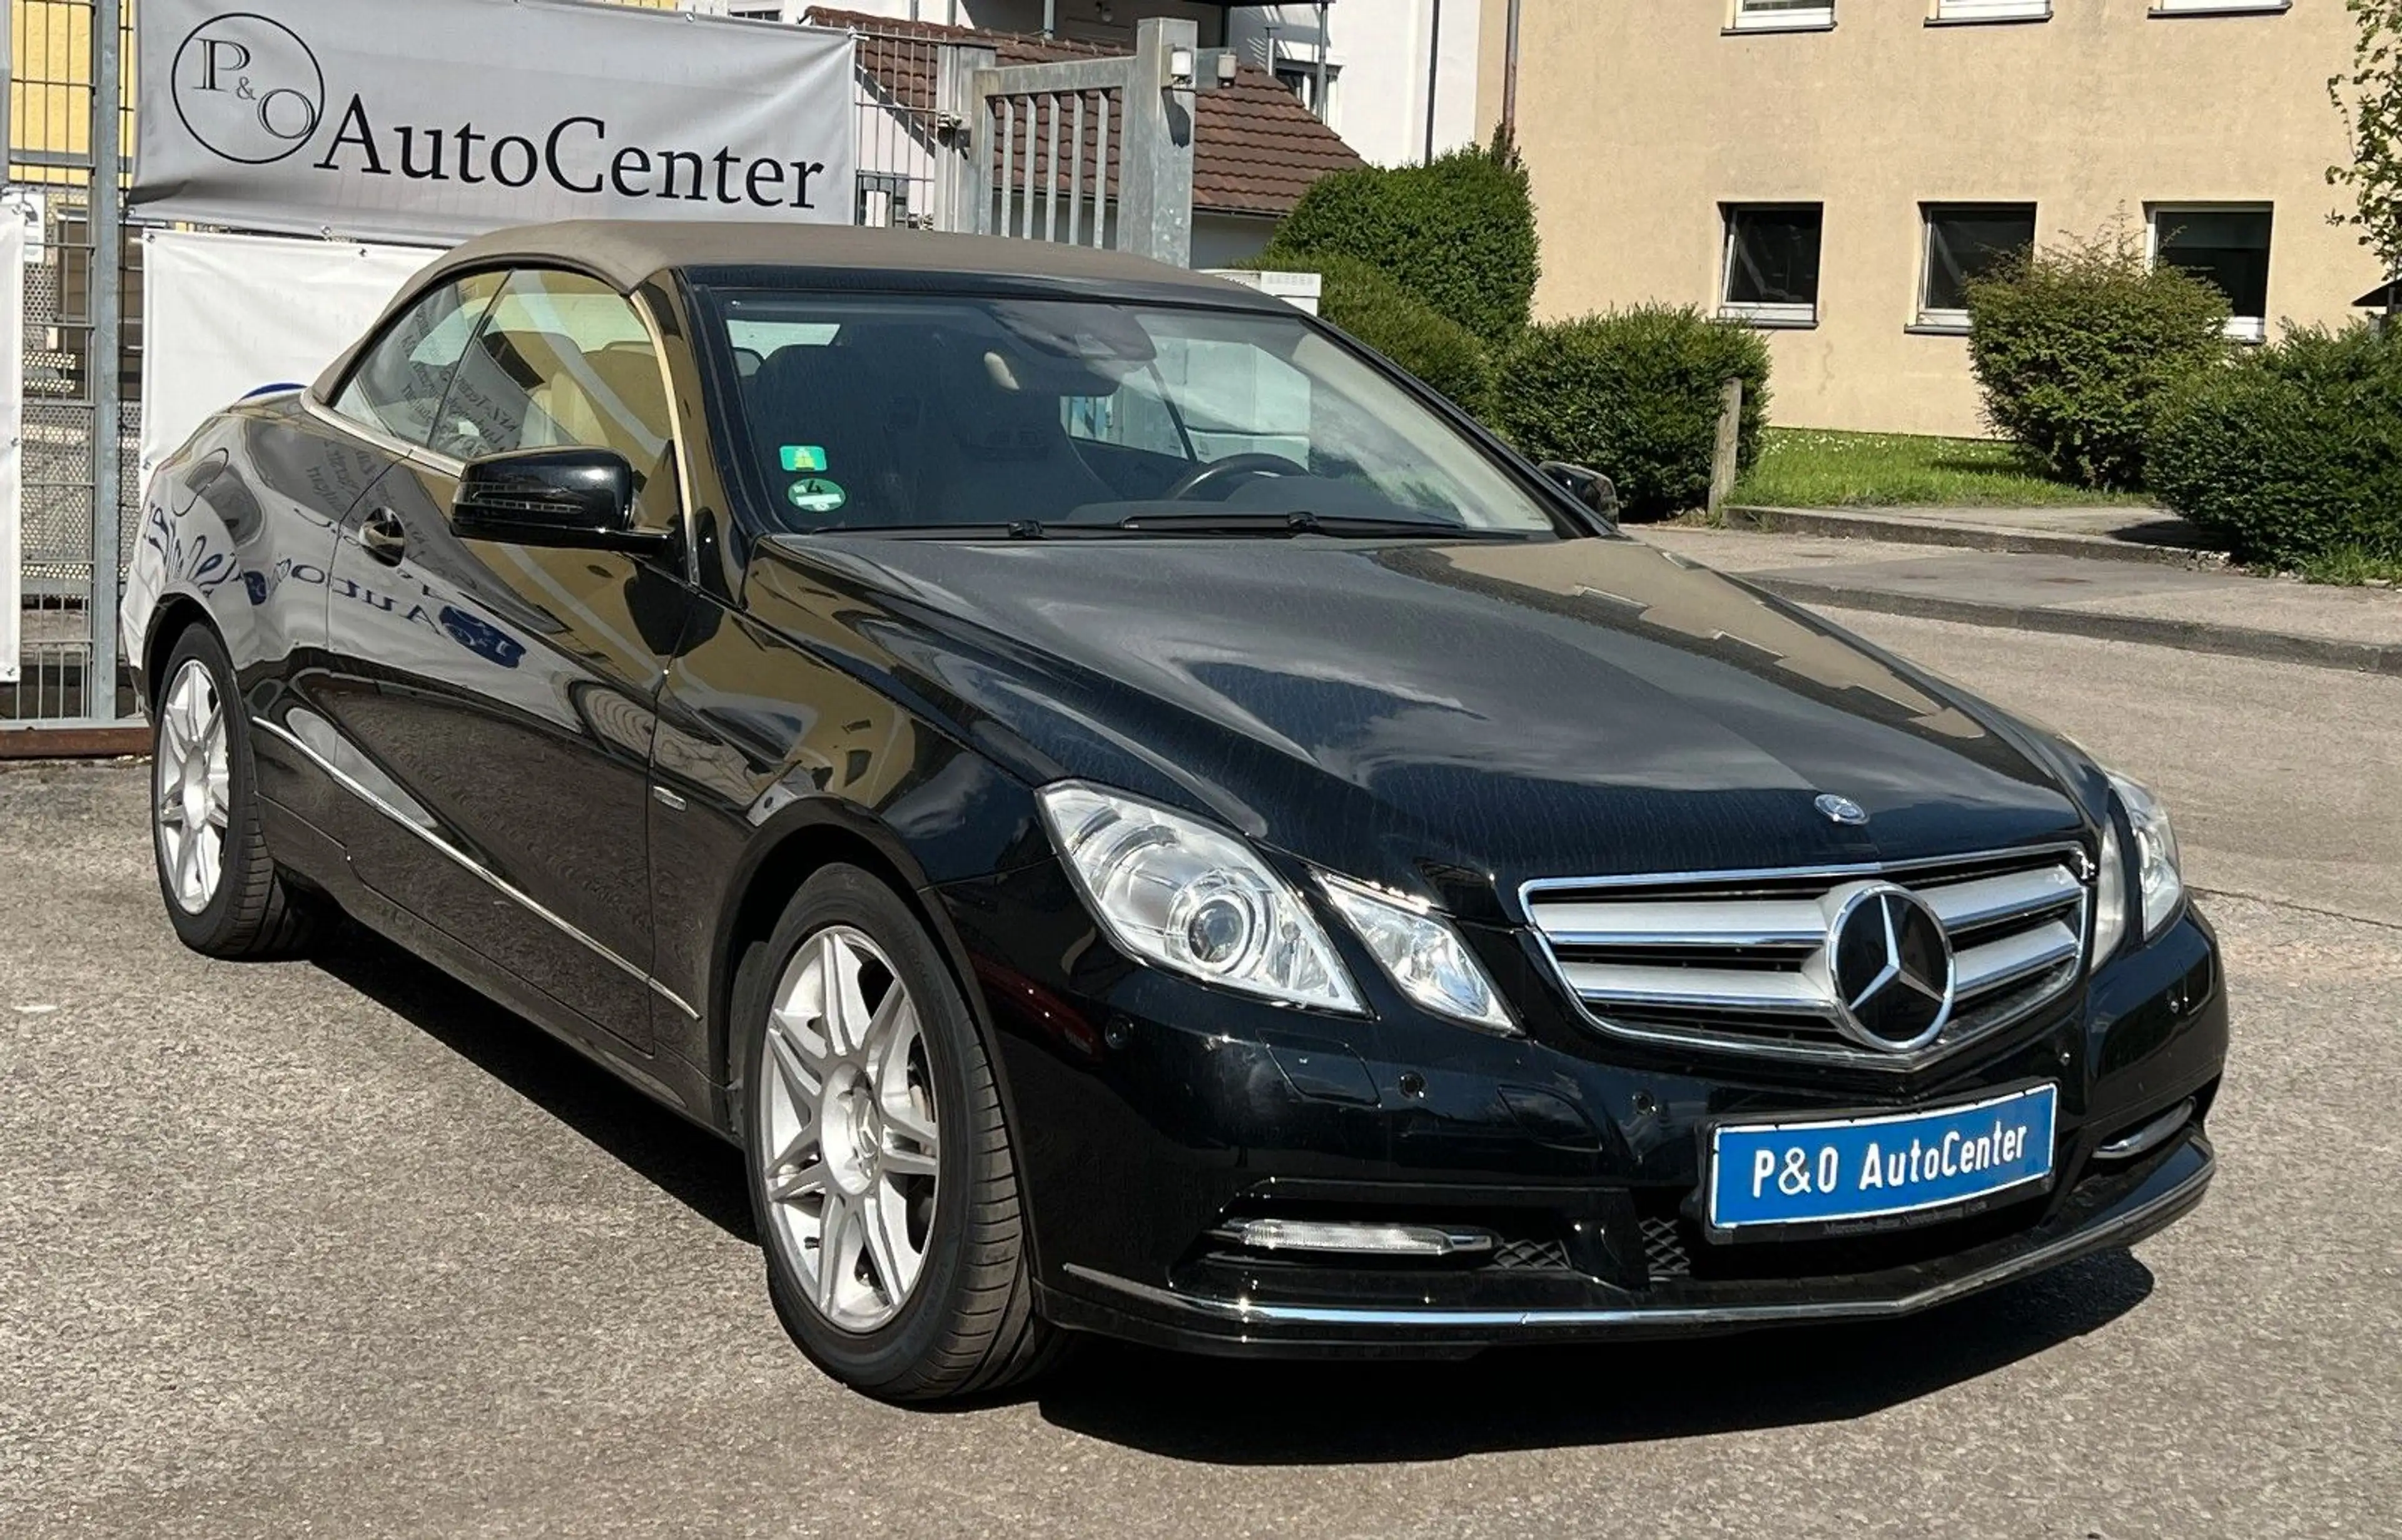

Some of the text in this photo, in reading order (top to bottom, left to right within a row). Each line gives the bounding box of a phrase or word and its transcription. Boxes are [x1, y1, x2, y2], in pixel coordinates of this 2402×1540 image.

[313, 93, 824, 209] AutoCenter
[1753, 1120, 2027, 1198] P&O AutoCenter
